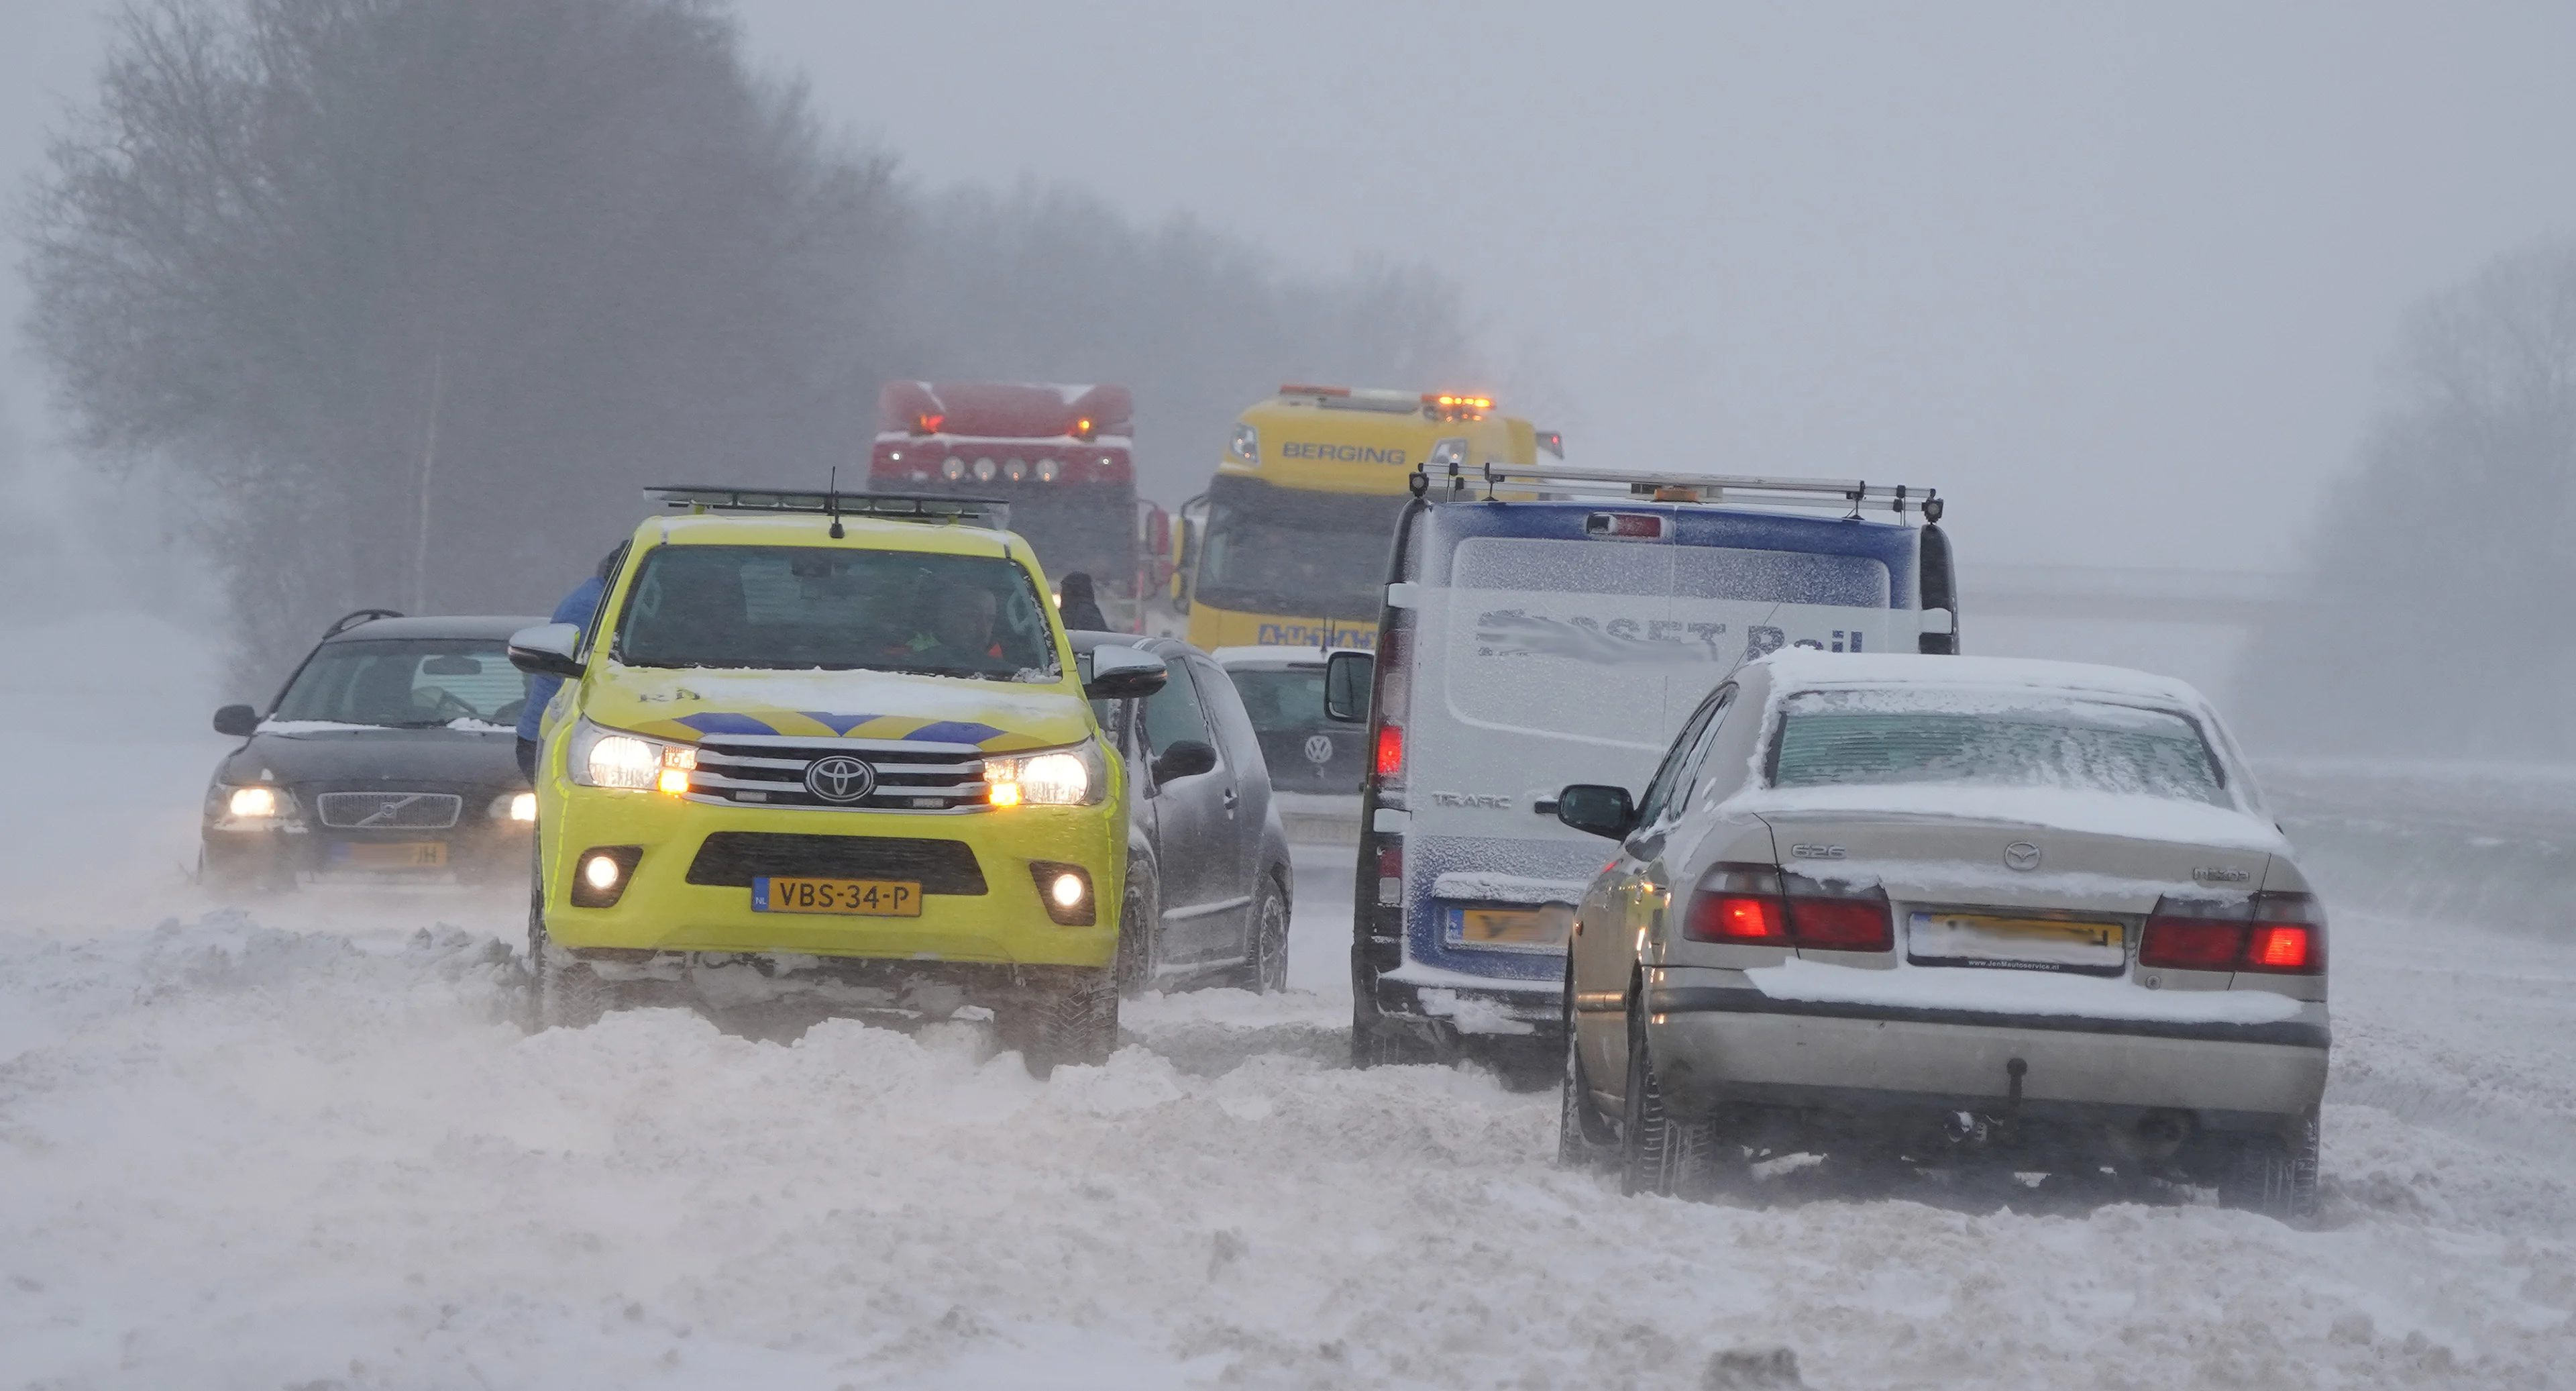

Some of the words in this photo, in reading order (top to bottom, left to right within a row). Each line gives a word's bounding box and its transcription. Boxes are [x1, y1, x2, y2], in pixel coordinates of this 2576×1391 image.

[1282, 441, 1406, 466] BERGING
[1260, 624, 1379, 649] AUTA
[1747, 625, 1863, 662] Ril
[1791, 843, 1845, 860] 626
[755, 897, 767, 905] NL
[780, 882, 909, 910] VBS-34-P
